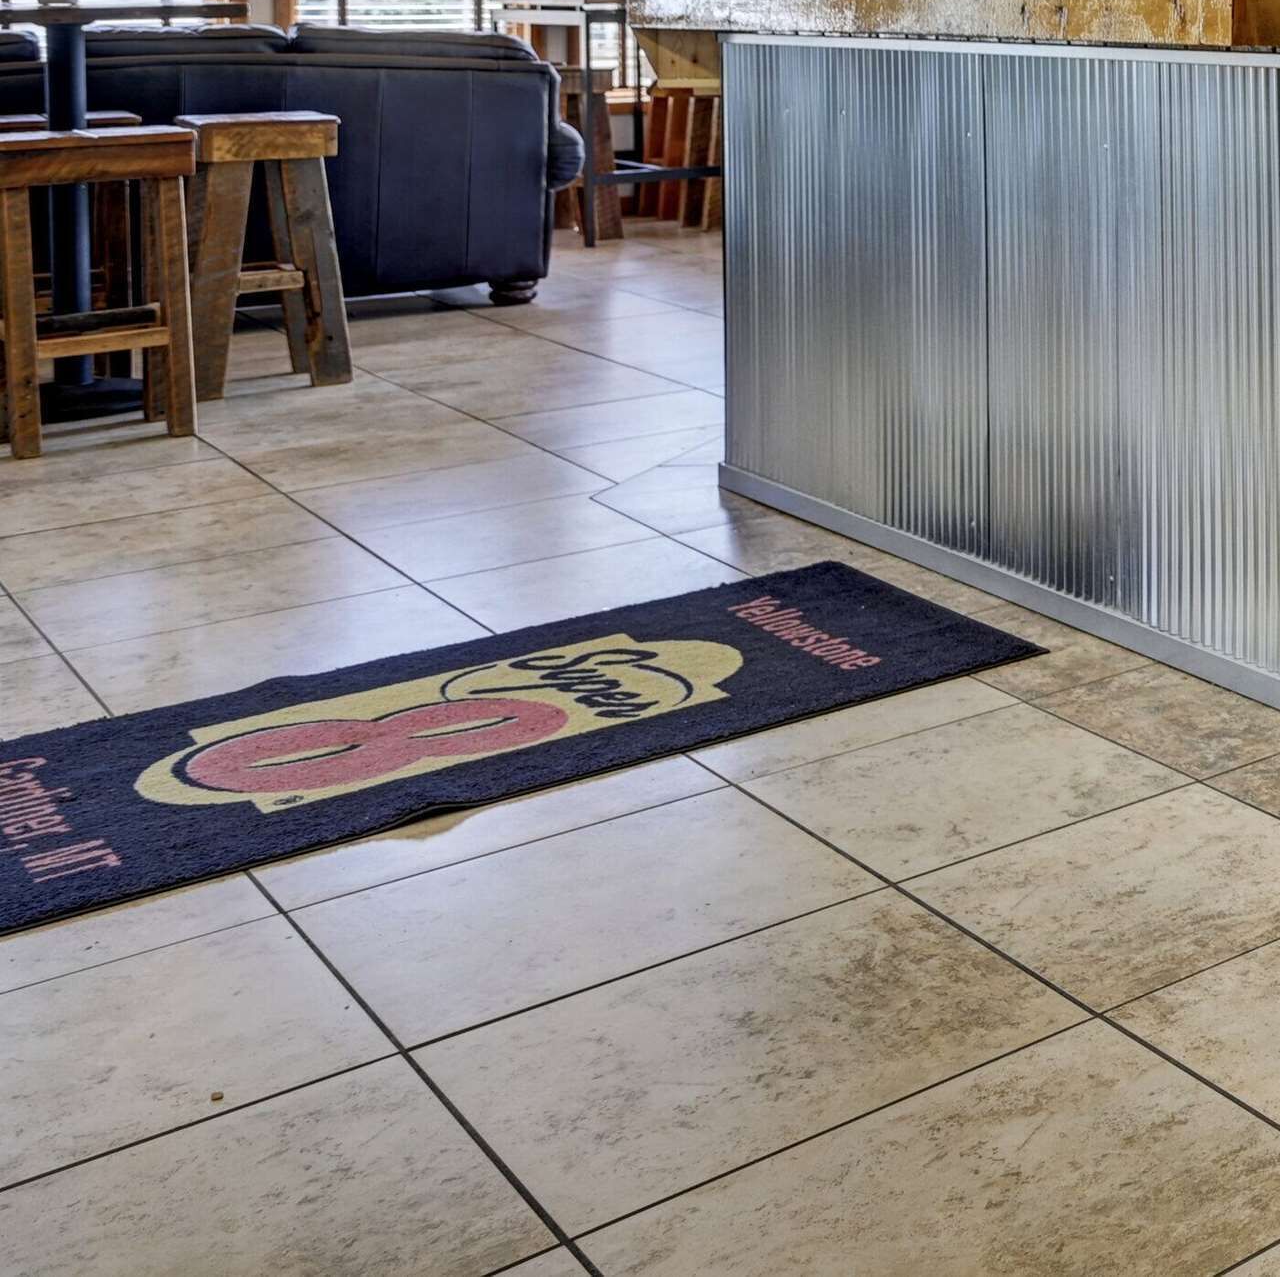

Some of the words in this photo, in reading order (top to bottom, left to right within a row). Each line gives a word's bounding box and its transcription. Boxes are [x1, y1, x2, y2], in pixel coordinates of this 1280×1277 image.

[728, 595, 882, 671] Yellowstone
[509, 648, 661, 719] Super
[170, 696, 571, 794] 8
[20, 839, 123, 883] MT
